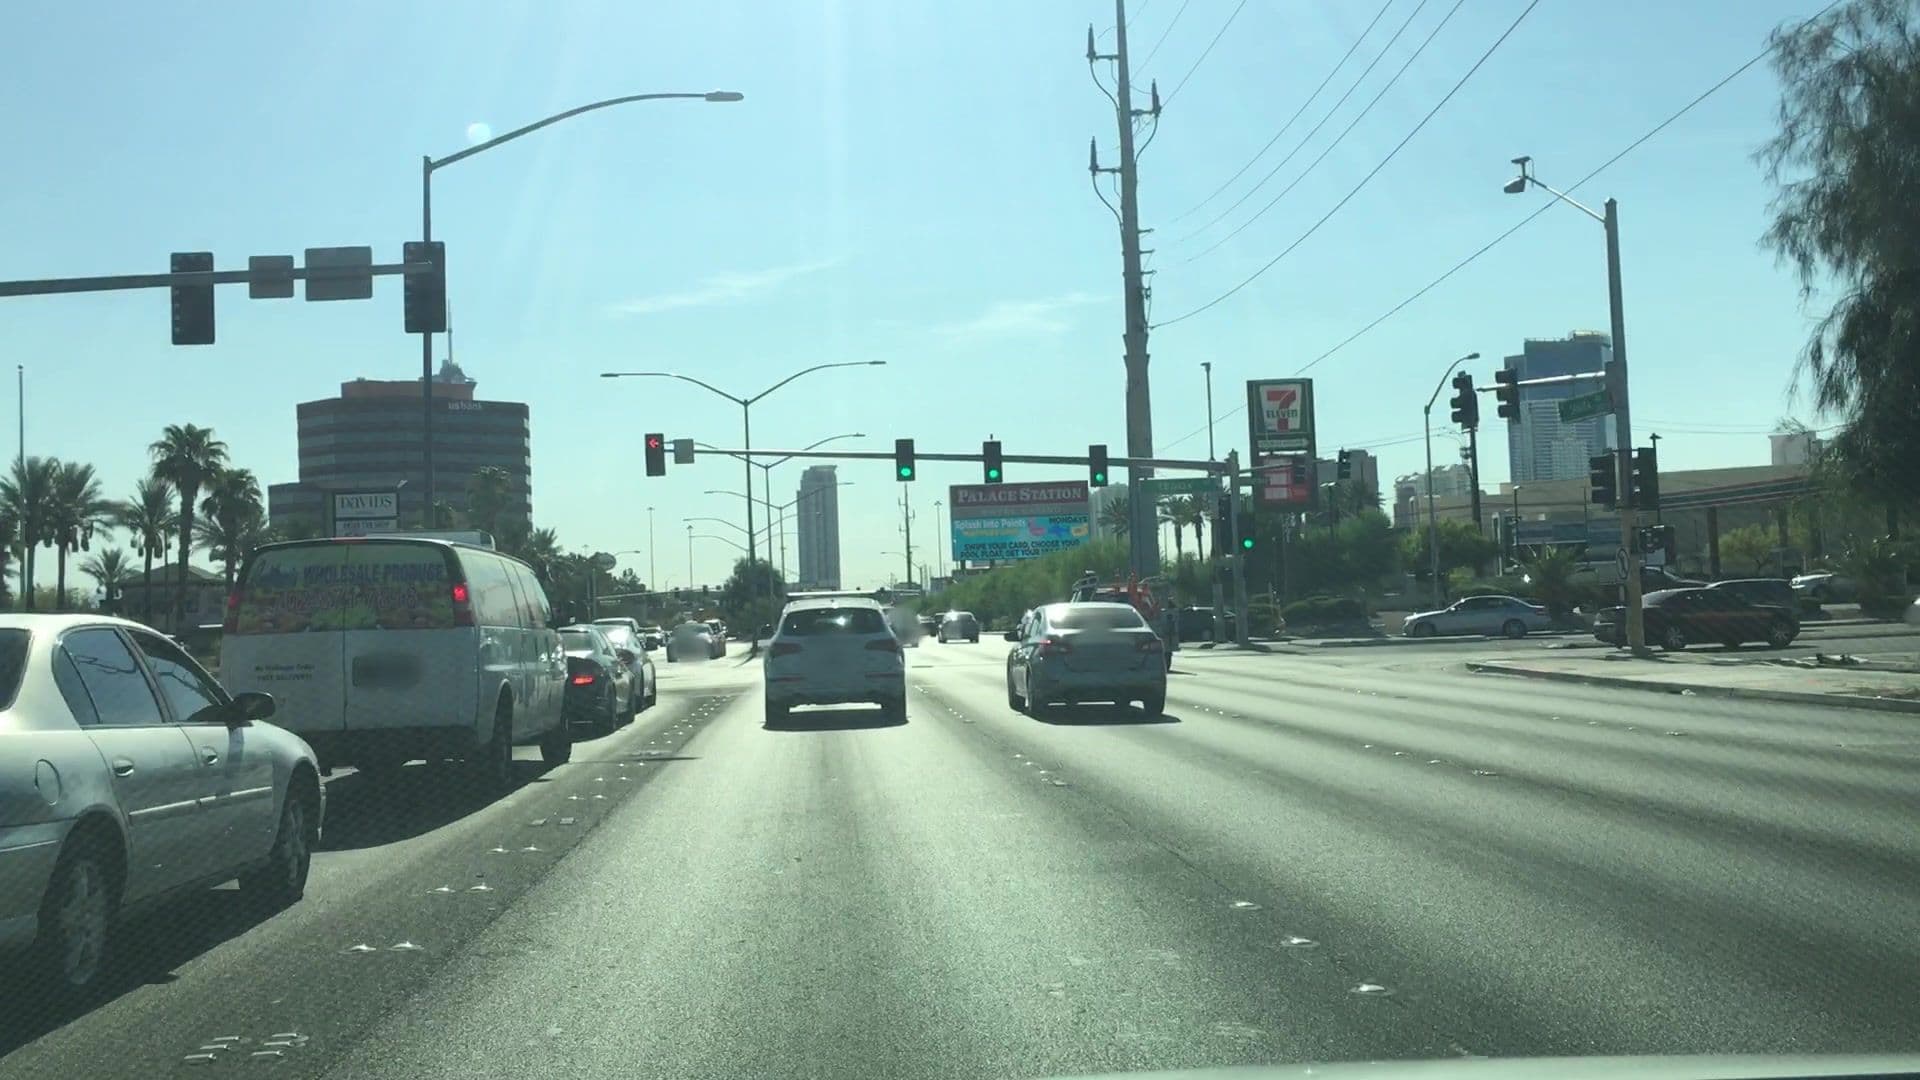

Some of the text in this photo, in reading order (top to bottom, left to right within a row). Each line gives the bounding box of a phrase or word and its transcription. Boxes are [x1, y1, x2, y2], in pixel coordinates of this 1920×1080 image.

[1266, 389, 1297, 431] 7
[957, 487, 1081, 503] PALACE STATION
[954, 520, 982, 530] Splash
[1001, 519, 1026, 528] Points
[303, 564, 382, 584] WHOLESALE
[383, 563, 445, 582] PRODUCE
